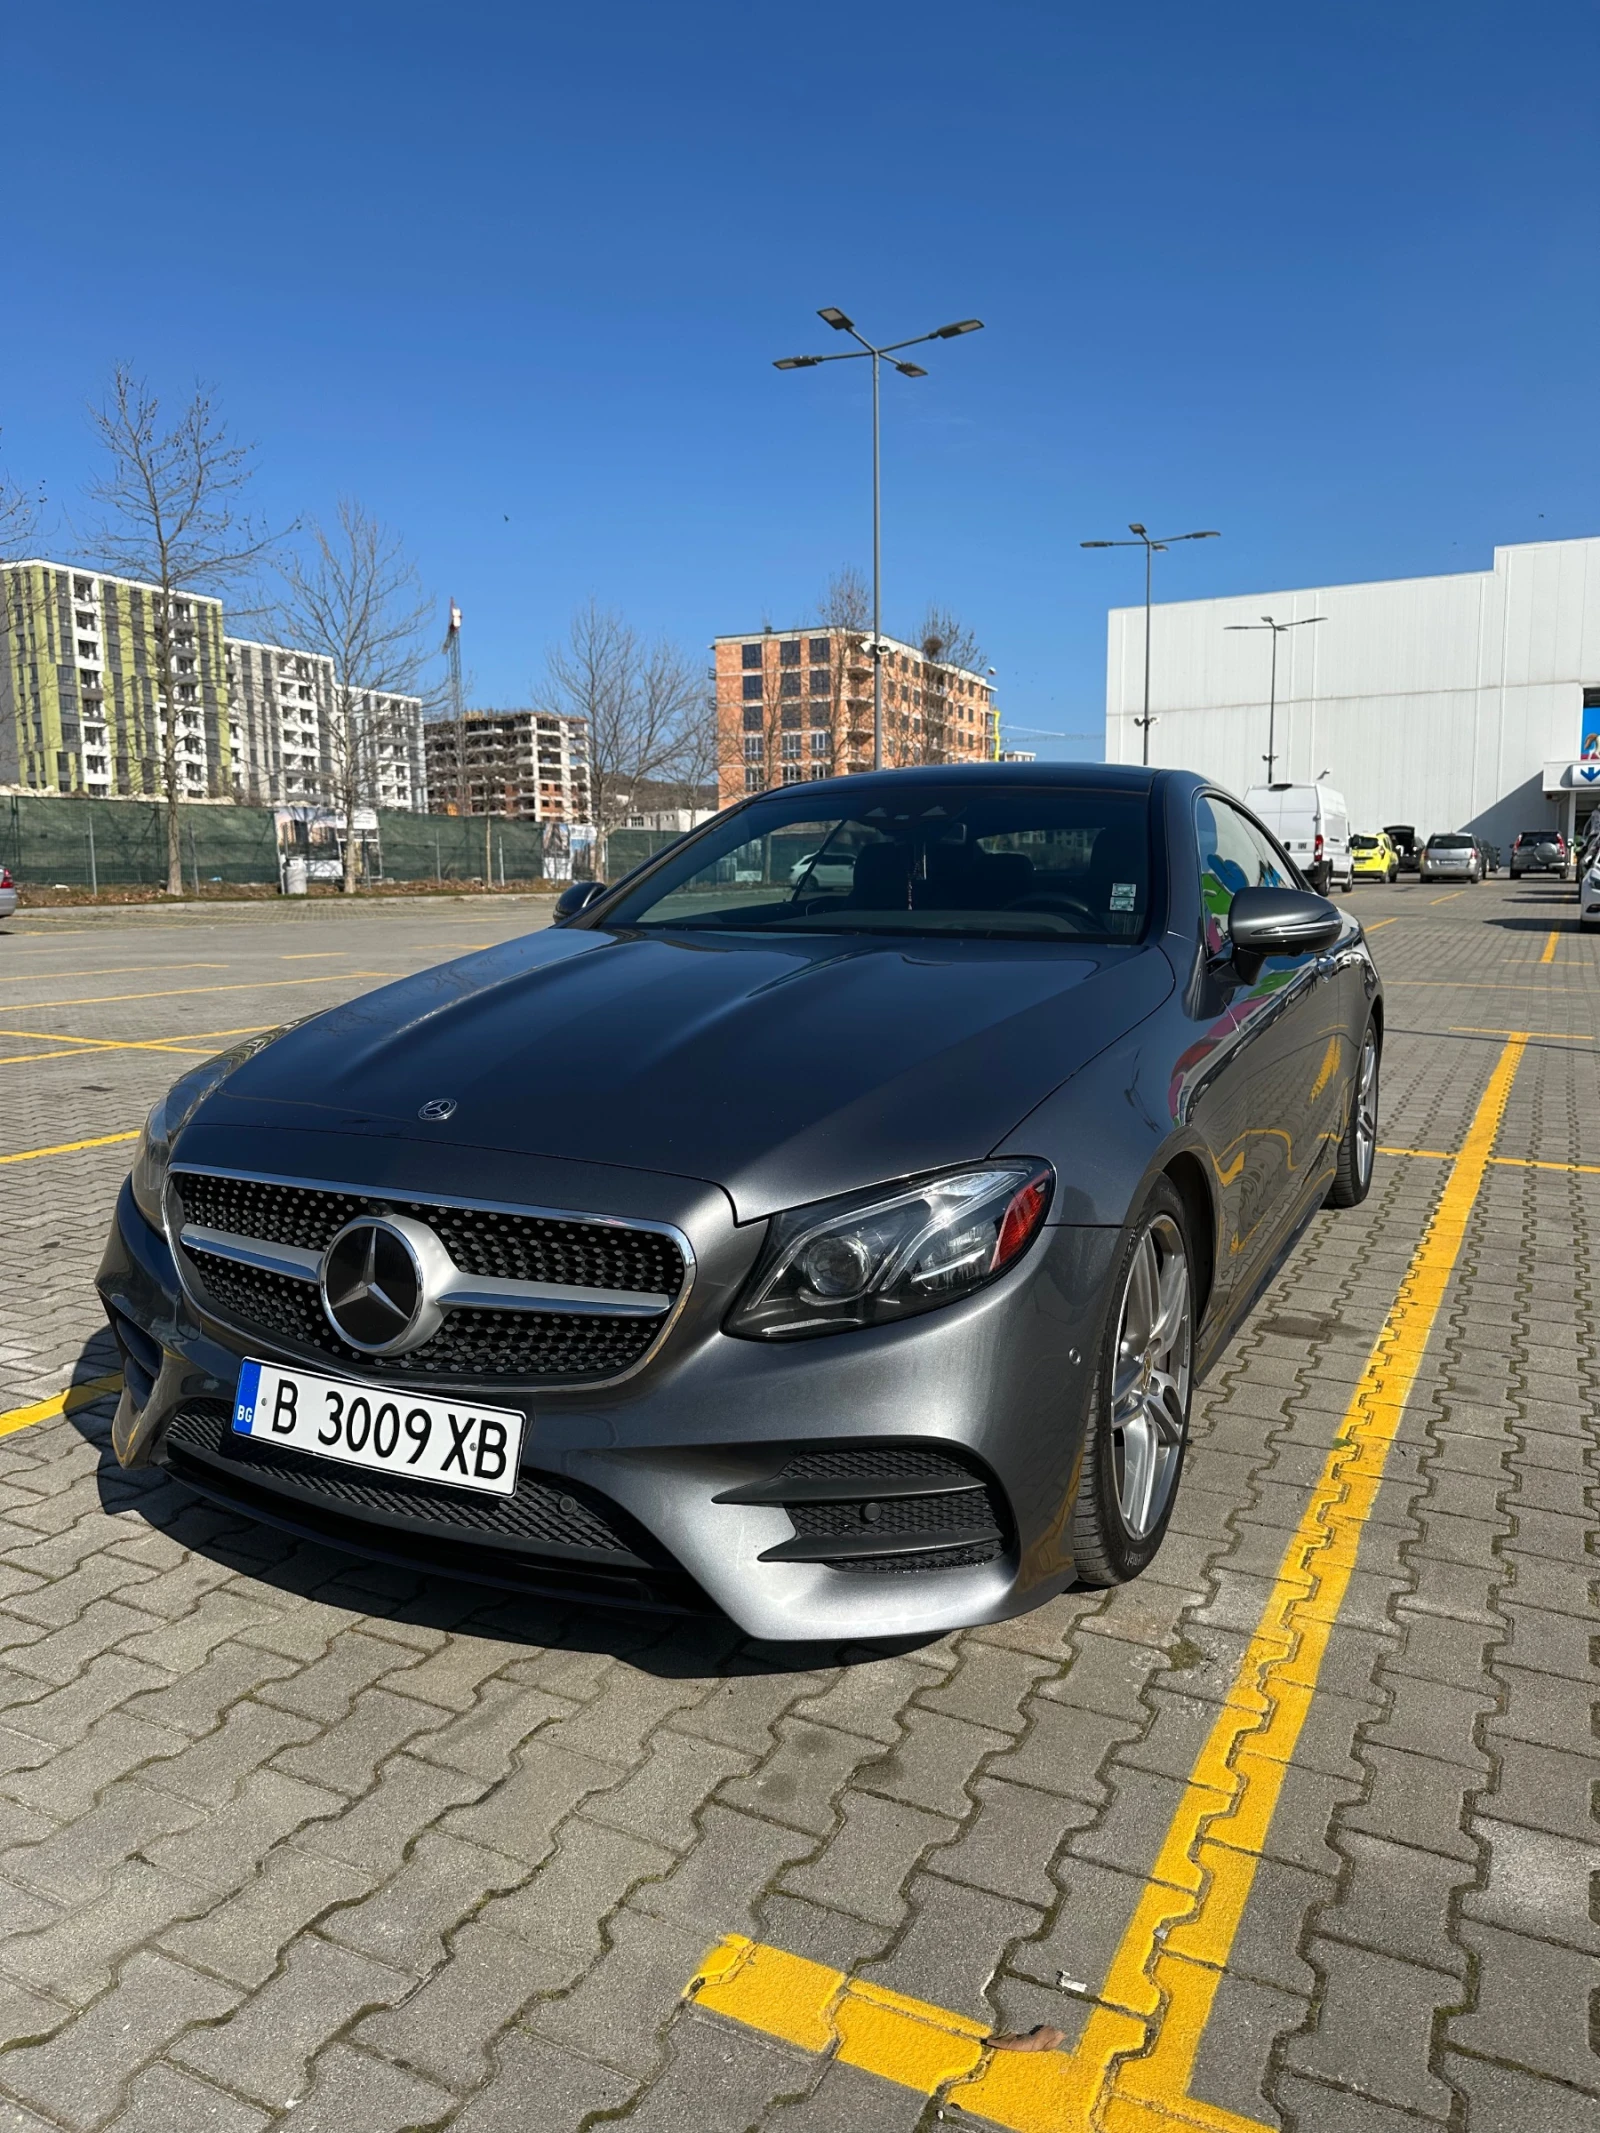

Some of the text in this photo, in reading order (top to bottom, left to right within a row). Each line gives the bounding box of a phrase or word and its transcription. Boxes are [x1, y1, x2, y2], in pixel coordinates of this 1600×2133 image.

[237, 1404, 253, 1423] BG
[272, 1378, 507, 1480] B 3009 XB
